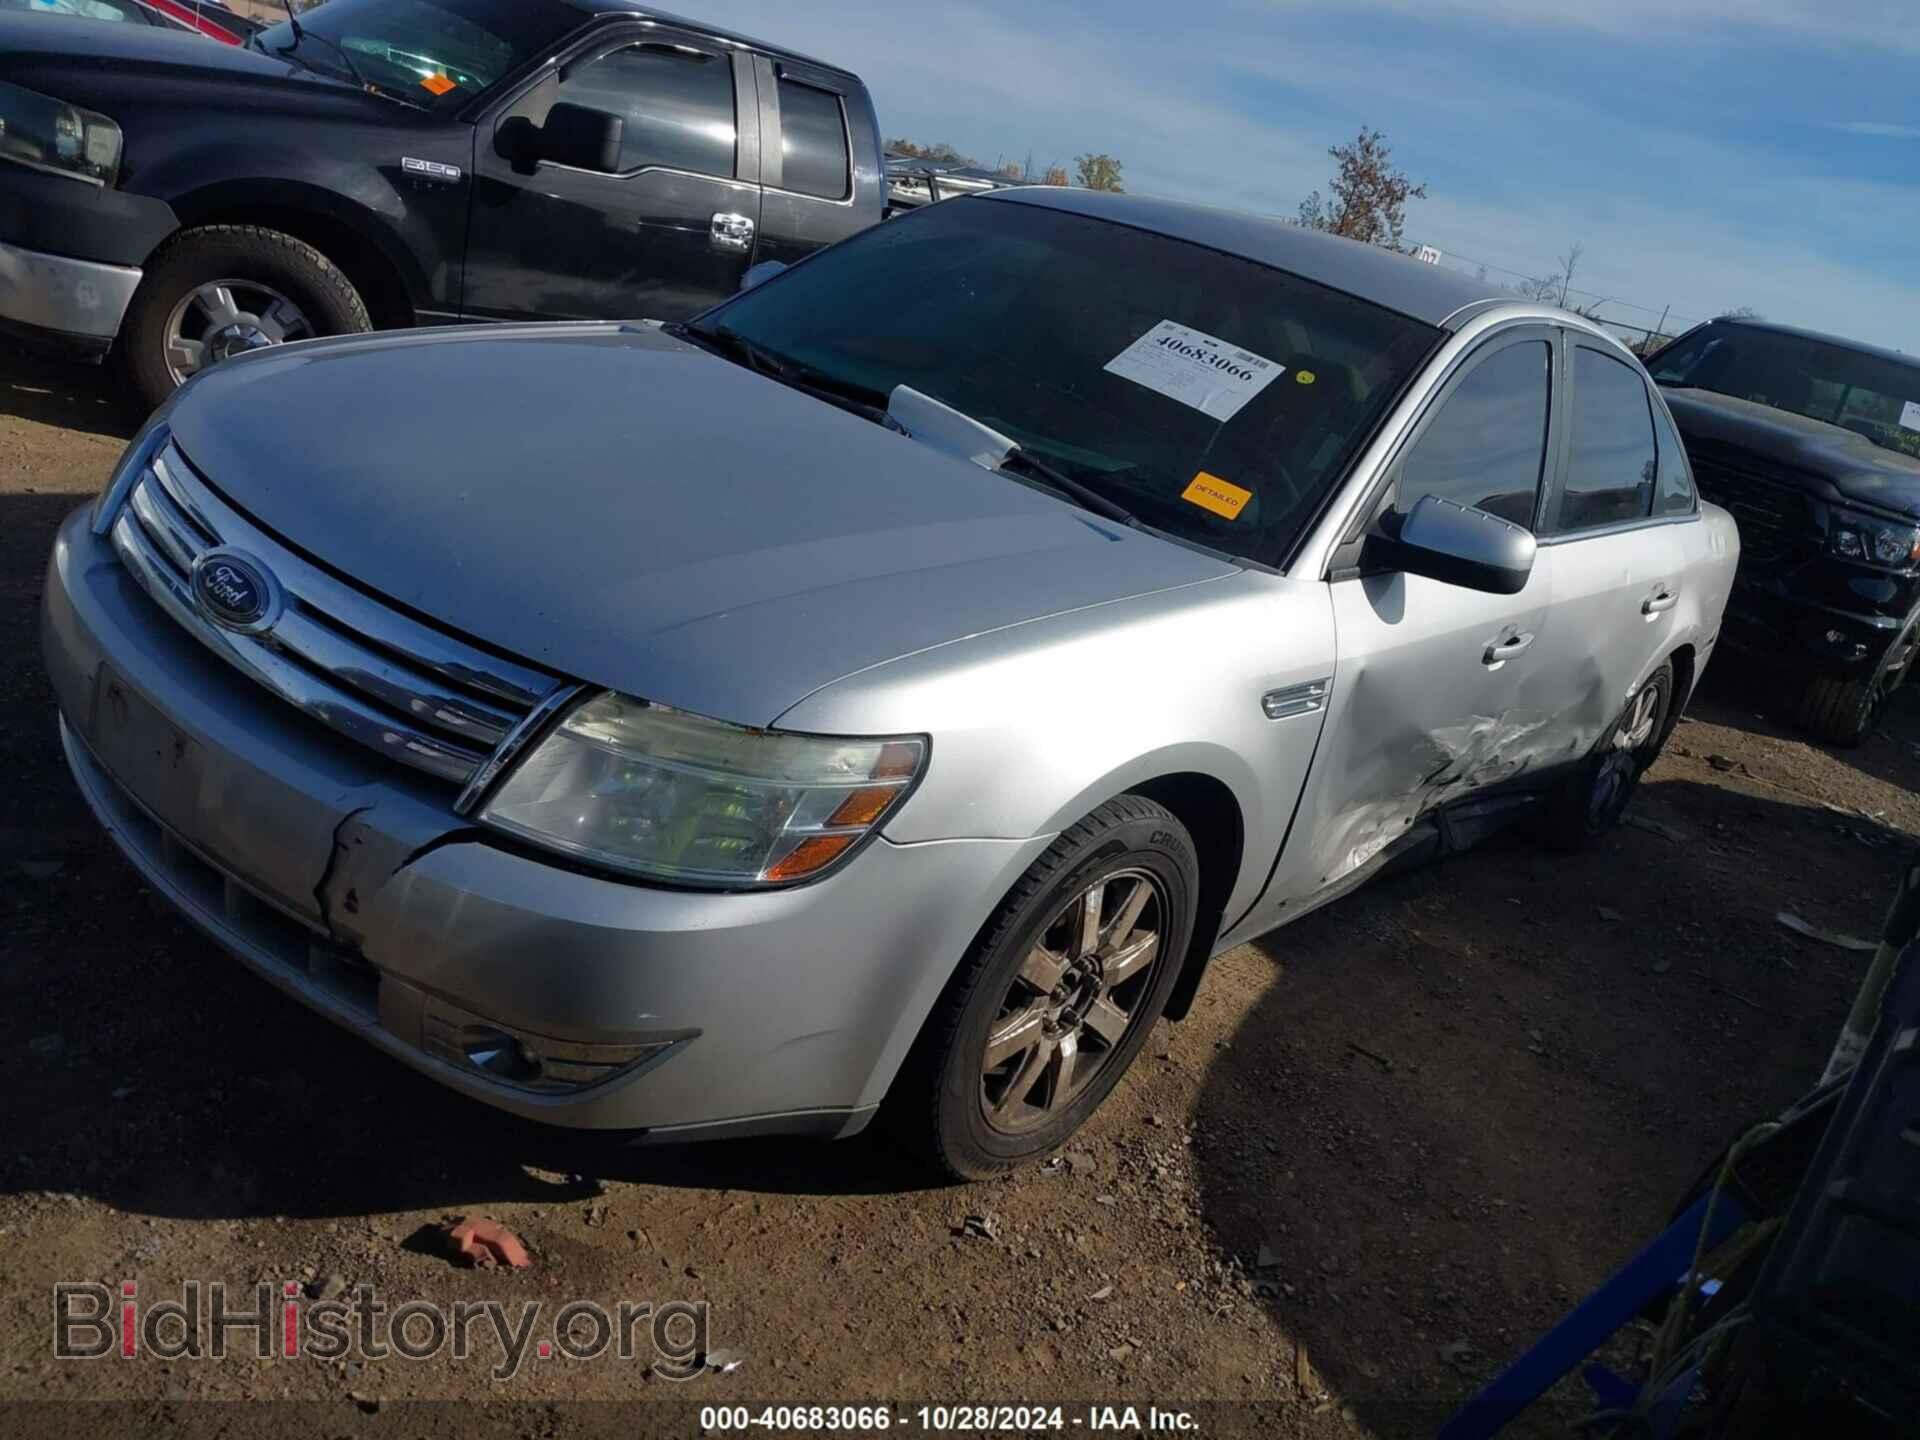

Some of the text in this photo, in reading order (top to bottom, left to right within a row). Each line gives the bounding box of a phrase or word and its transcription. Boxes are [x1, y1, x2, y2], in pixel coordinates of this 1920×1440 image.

[1156, 336, 1254, 382] 40683066
[1195, 483, 1239, 506] DETAILED
[206, 566, 249, 607] Ford
